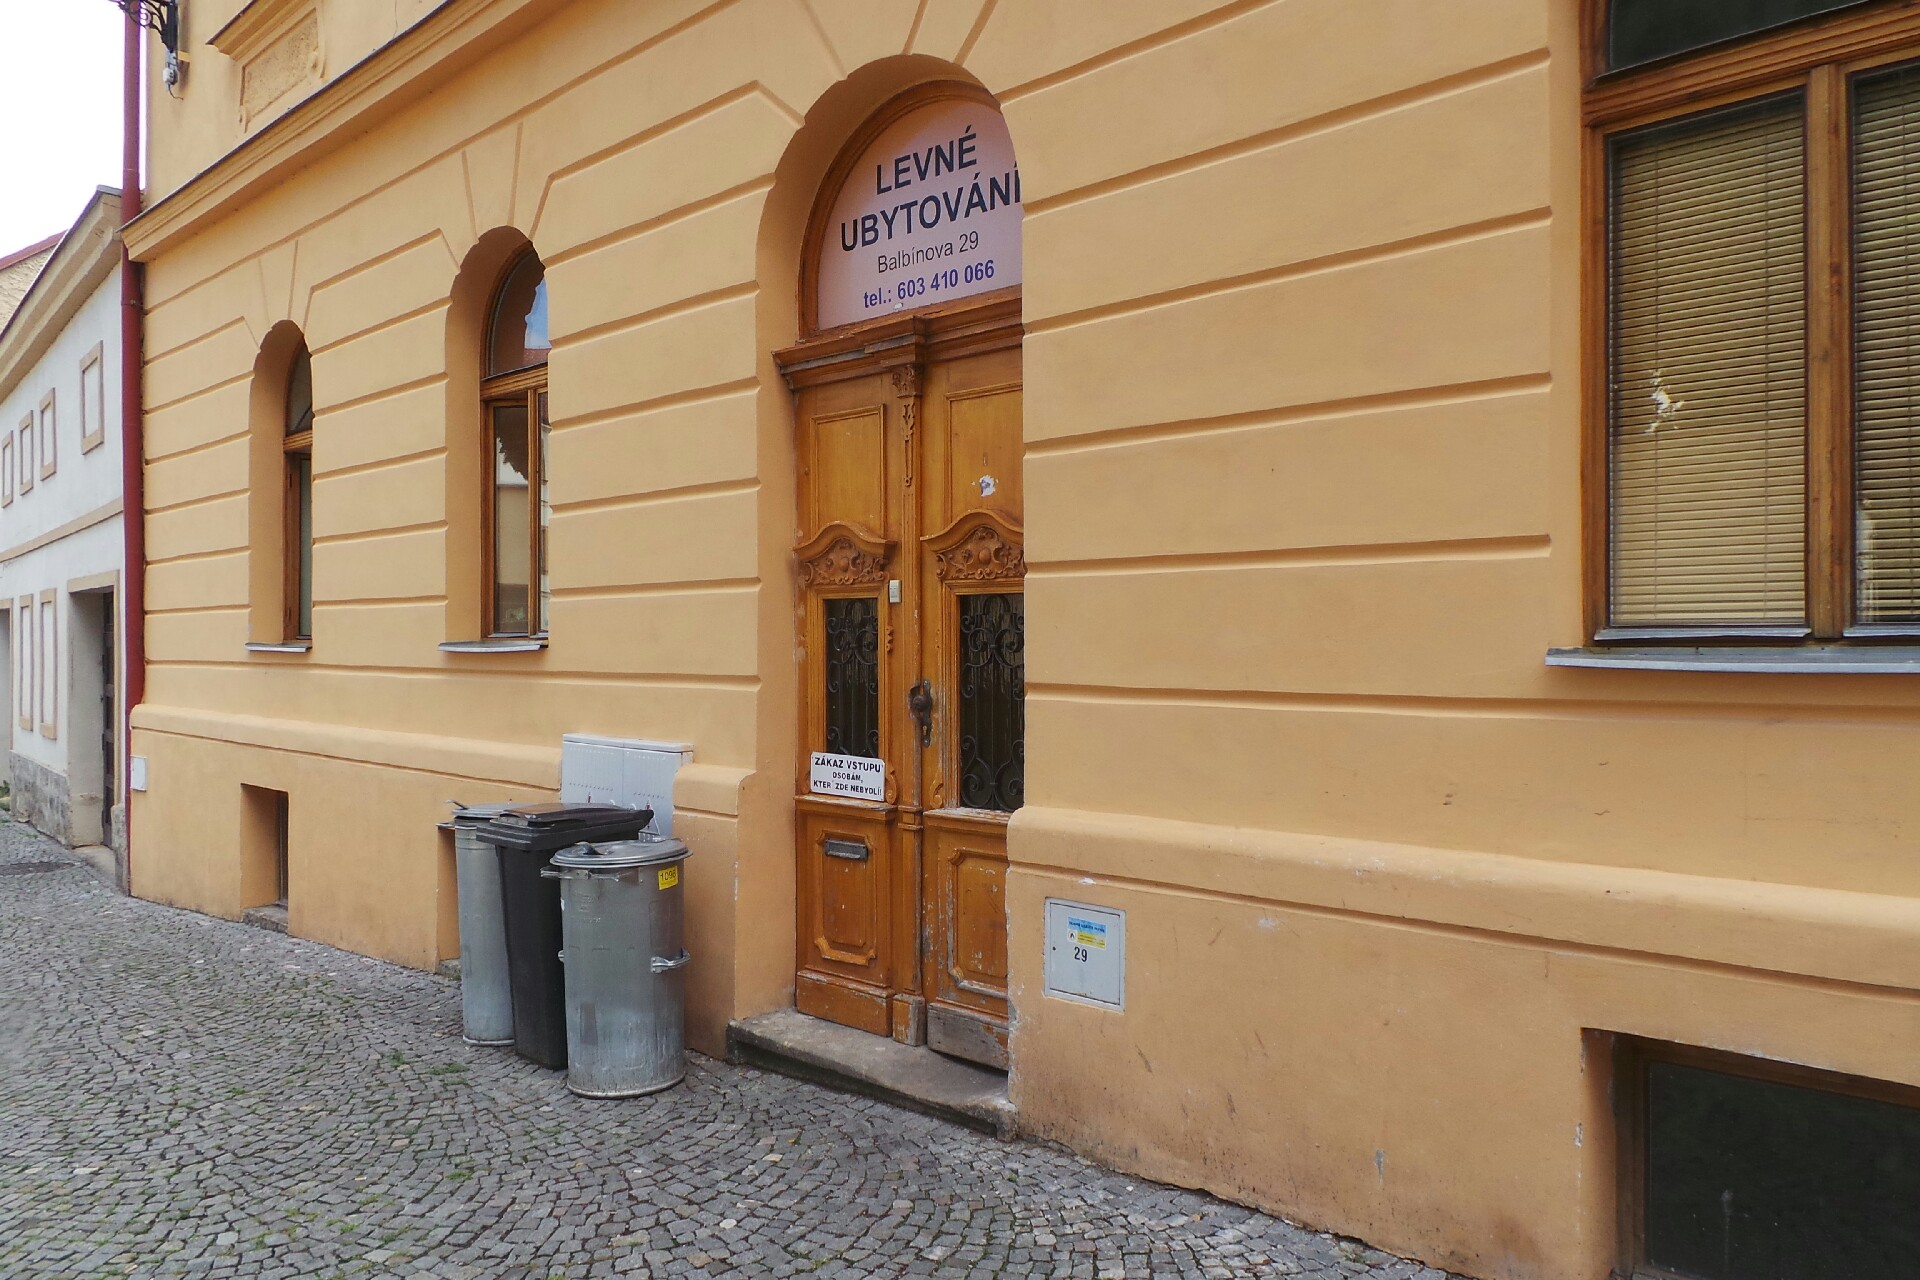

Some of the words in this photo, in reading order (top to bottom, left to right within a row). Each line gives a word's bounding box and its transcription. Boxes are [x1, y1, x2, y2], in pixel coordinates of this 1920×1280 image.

[876, 125, 977, 195] LEVNÉ
[841, 161, 1021, 252] UBYTOVÁNÍ
[878, 241, 953, 274] Balbínova
[959, 231, 979, 254] 29
[864, 287, 892, 308] tel.:
[897, 277, 925, 300] 603
[931, 269, 958, 291] 410
[964, 260, 995, 283] 066
[815, 755, 844, 768] ZÁKAZ
[846, 760, 881, 773] VSTUPU
[832, 772, 863, 783] OSOBÁM,
[835, 782, 848, 791] ZDE
[850, 785, 882, 796] NEBYDLÍ!
[1074, 946, 1088, 962] 29
